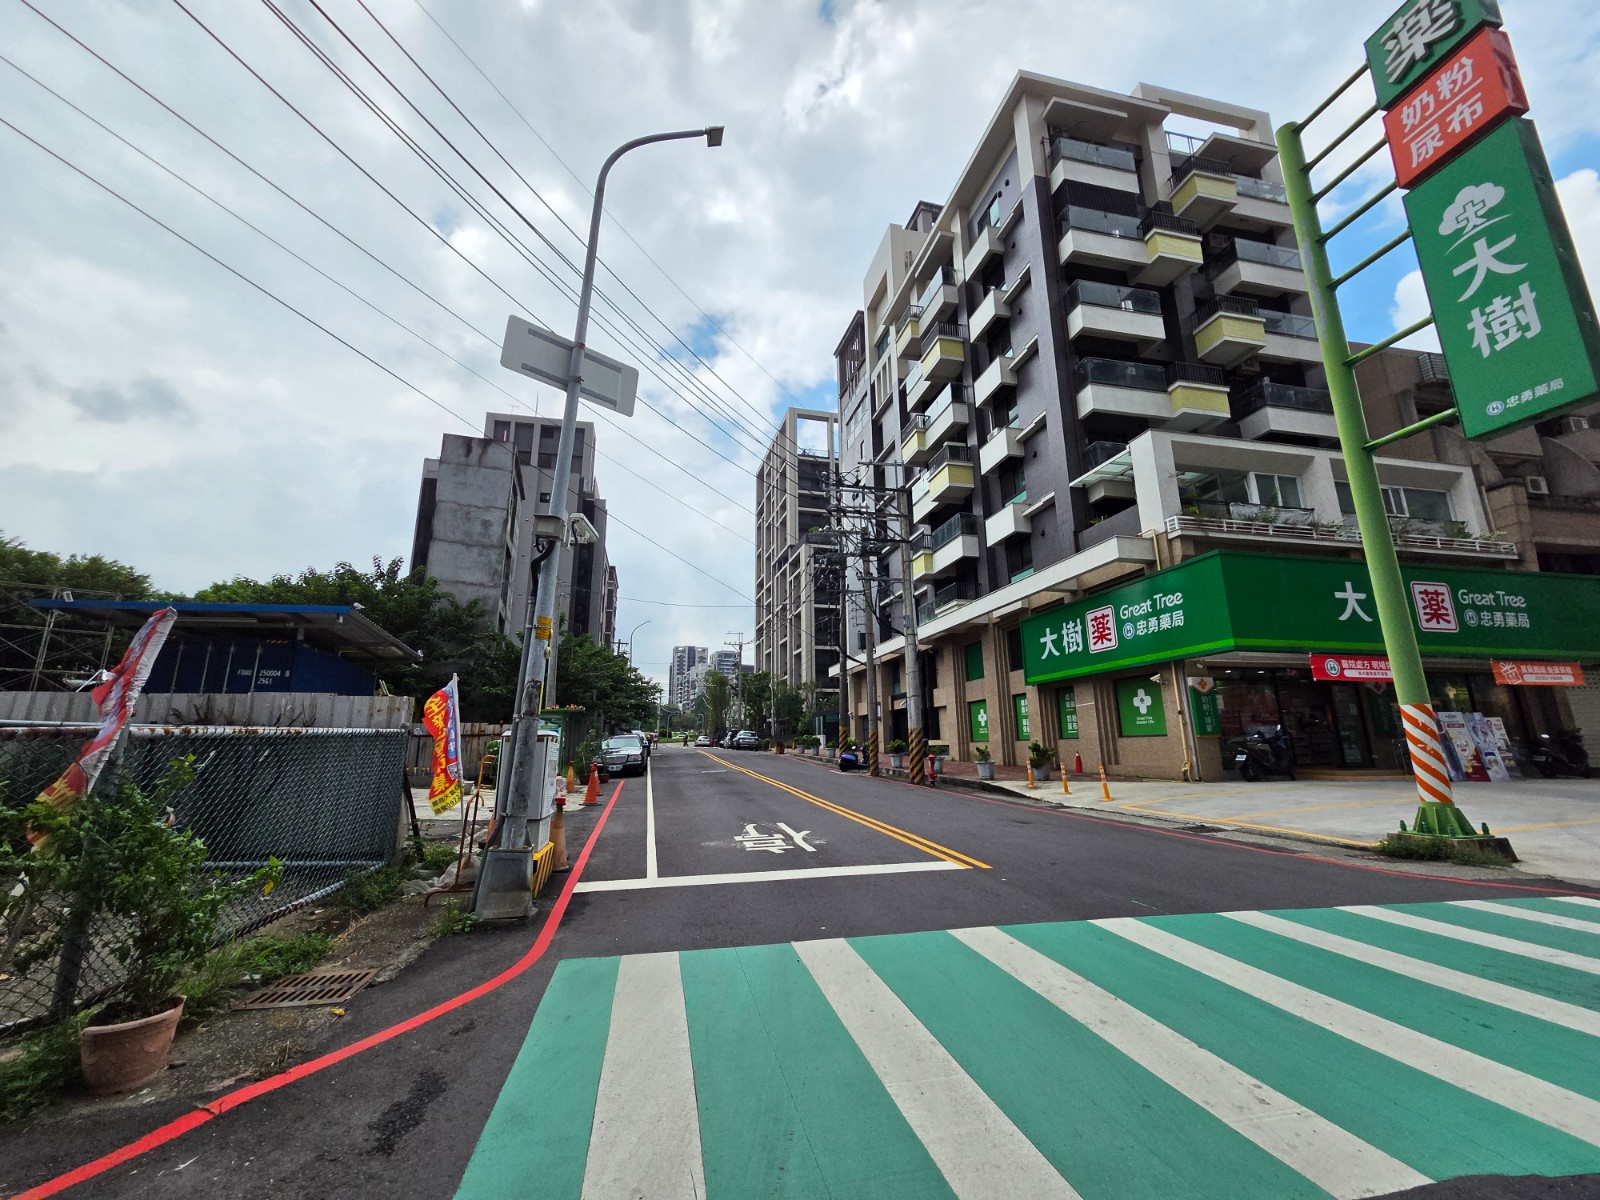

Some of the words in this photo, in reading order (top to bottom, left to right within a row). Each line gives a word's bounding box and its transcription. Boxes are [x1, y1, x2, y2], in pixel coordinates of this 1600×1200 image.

[1400, 56, 1474, 133] 奶粉
[1411, 92, 1483, 169] 尿布
[1452, 233, 1542, 359] 大樹
[1505, 378, 1564, 408] 忠勇藥局
[1120, 599, 1153, 619] Great
[1153, 592, 1183, 609] Tree
[1458, 589, 1496, 605] Great
[1497, 591, 1527, 608] Tree
[1136, 610, 1184, 635] 忠勇藥局
[1480, 611, 1530, 629] 忠勇藥局
[1040, 619, 1083, 660] 大樹
